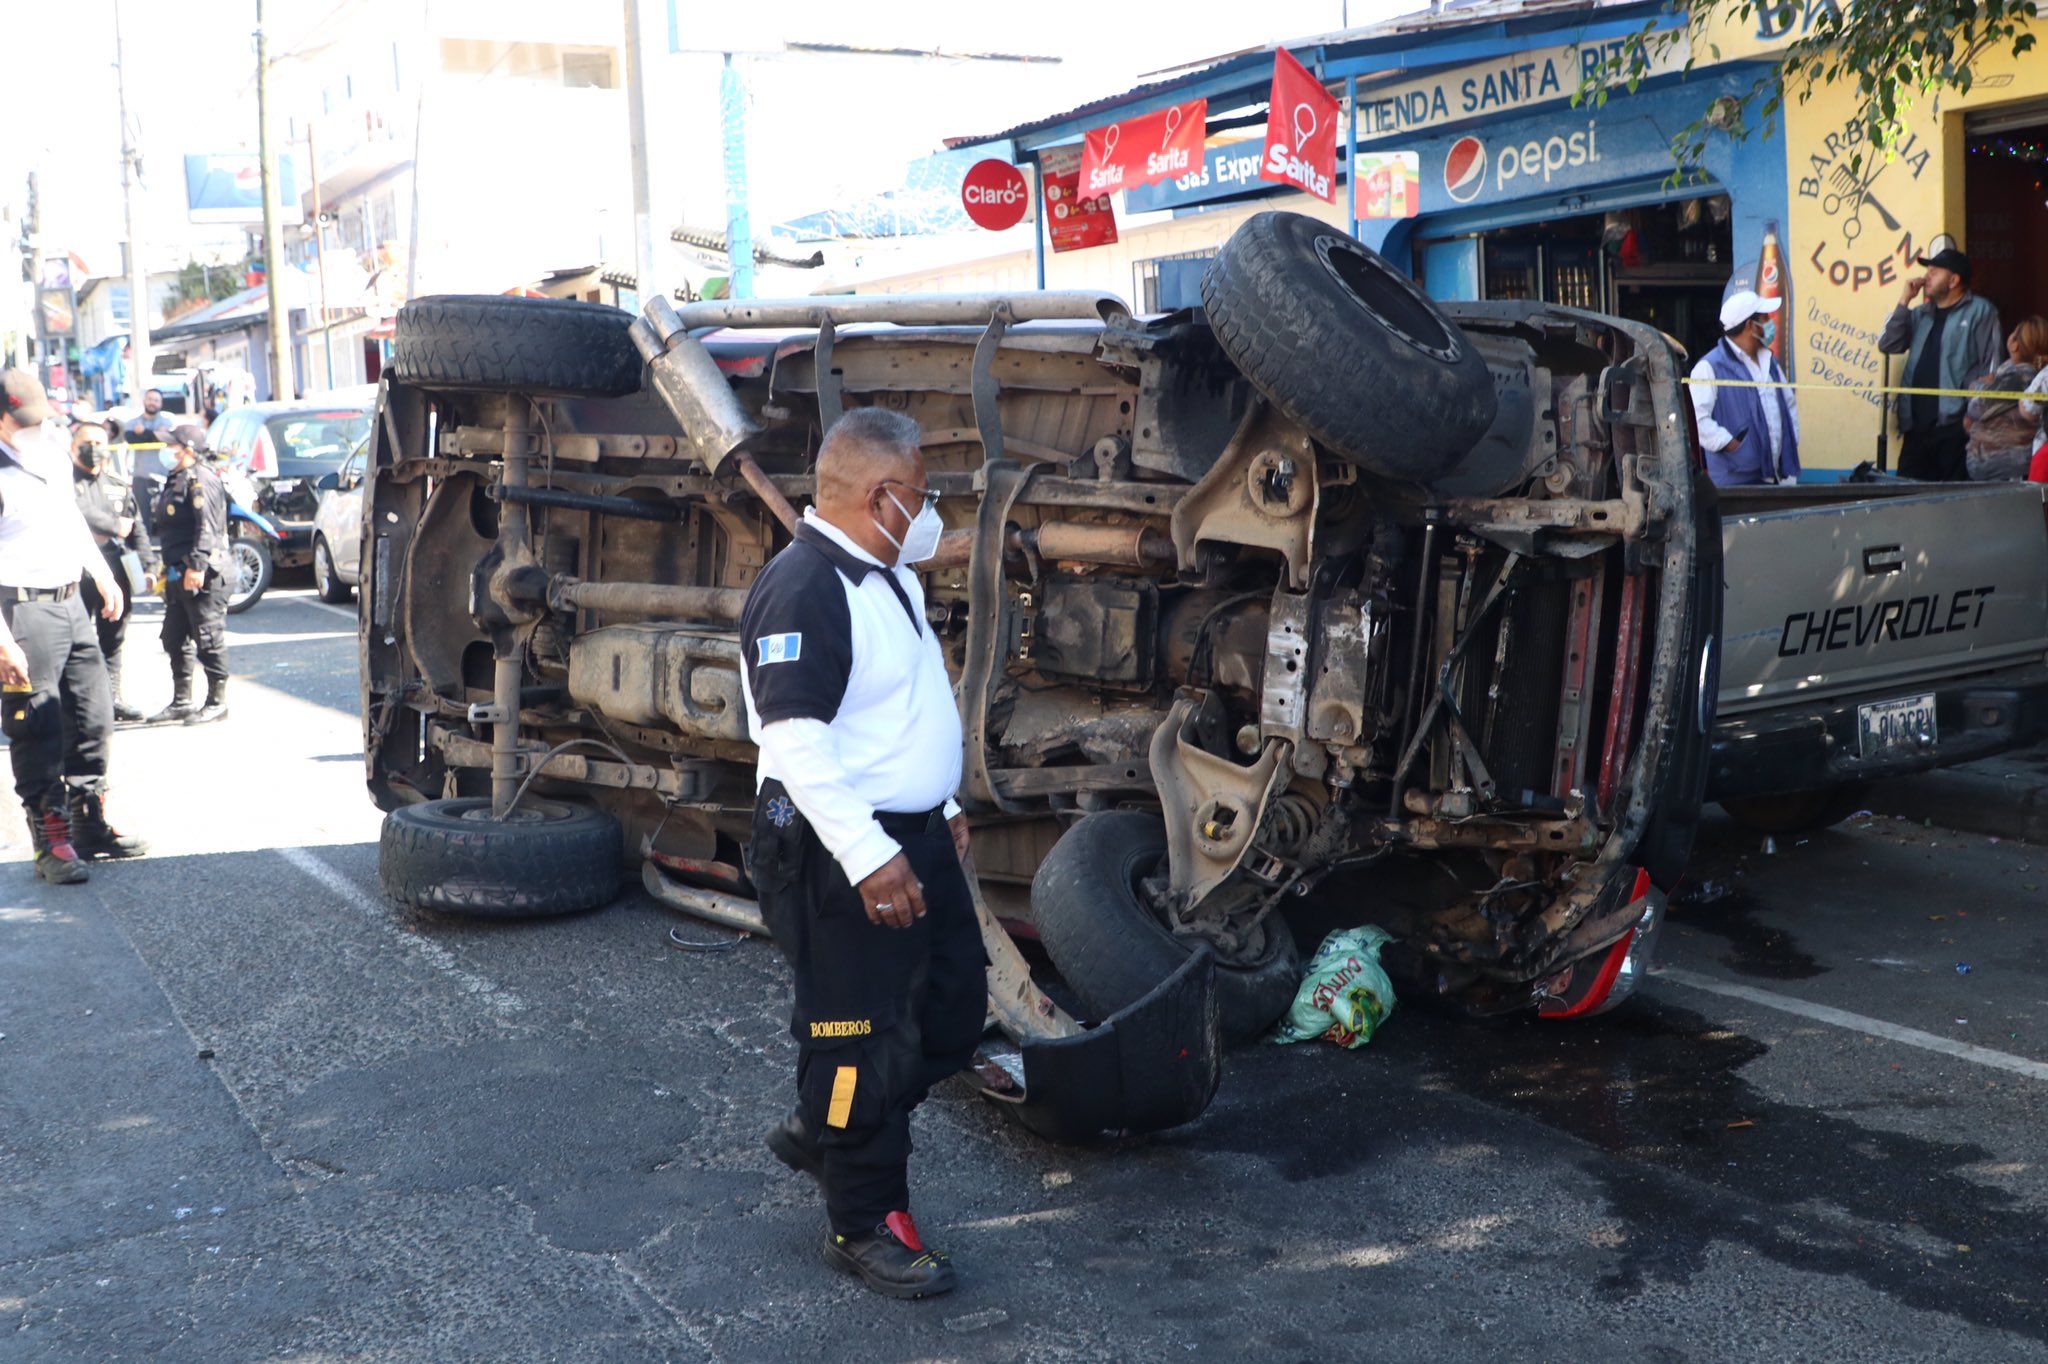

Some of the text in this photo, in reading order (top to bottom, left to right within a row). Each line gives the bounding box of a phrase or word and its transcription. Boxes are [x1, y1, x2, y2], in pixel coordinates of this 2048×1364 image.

[1360, 35, 1652, 134] TIENDA SANTA RITA
[1088, 164, 1124, 191] Sarita
[1146, 147, 1188, 176] Sarita
[1215, 153, 1263, 185] Expr
[1265, 143, 1330, 199] Sarita
[1497, 119, 1599, 191] pepsi
[1799, 118, 1931, 199] BARBIA
[965, 182, 1019, 205] Claro
[1807, 296, 1879, 346] Usamos
[1810, 332, 1879, 374] Gillette
[1777, 586, 1996, 658] CHEVROLET
[809, 1018, 872, 1039] BOMBEROS
